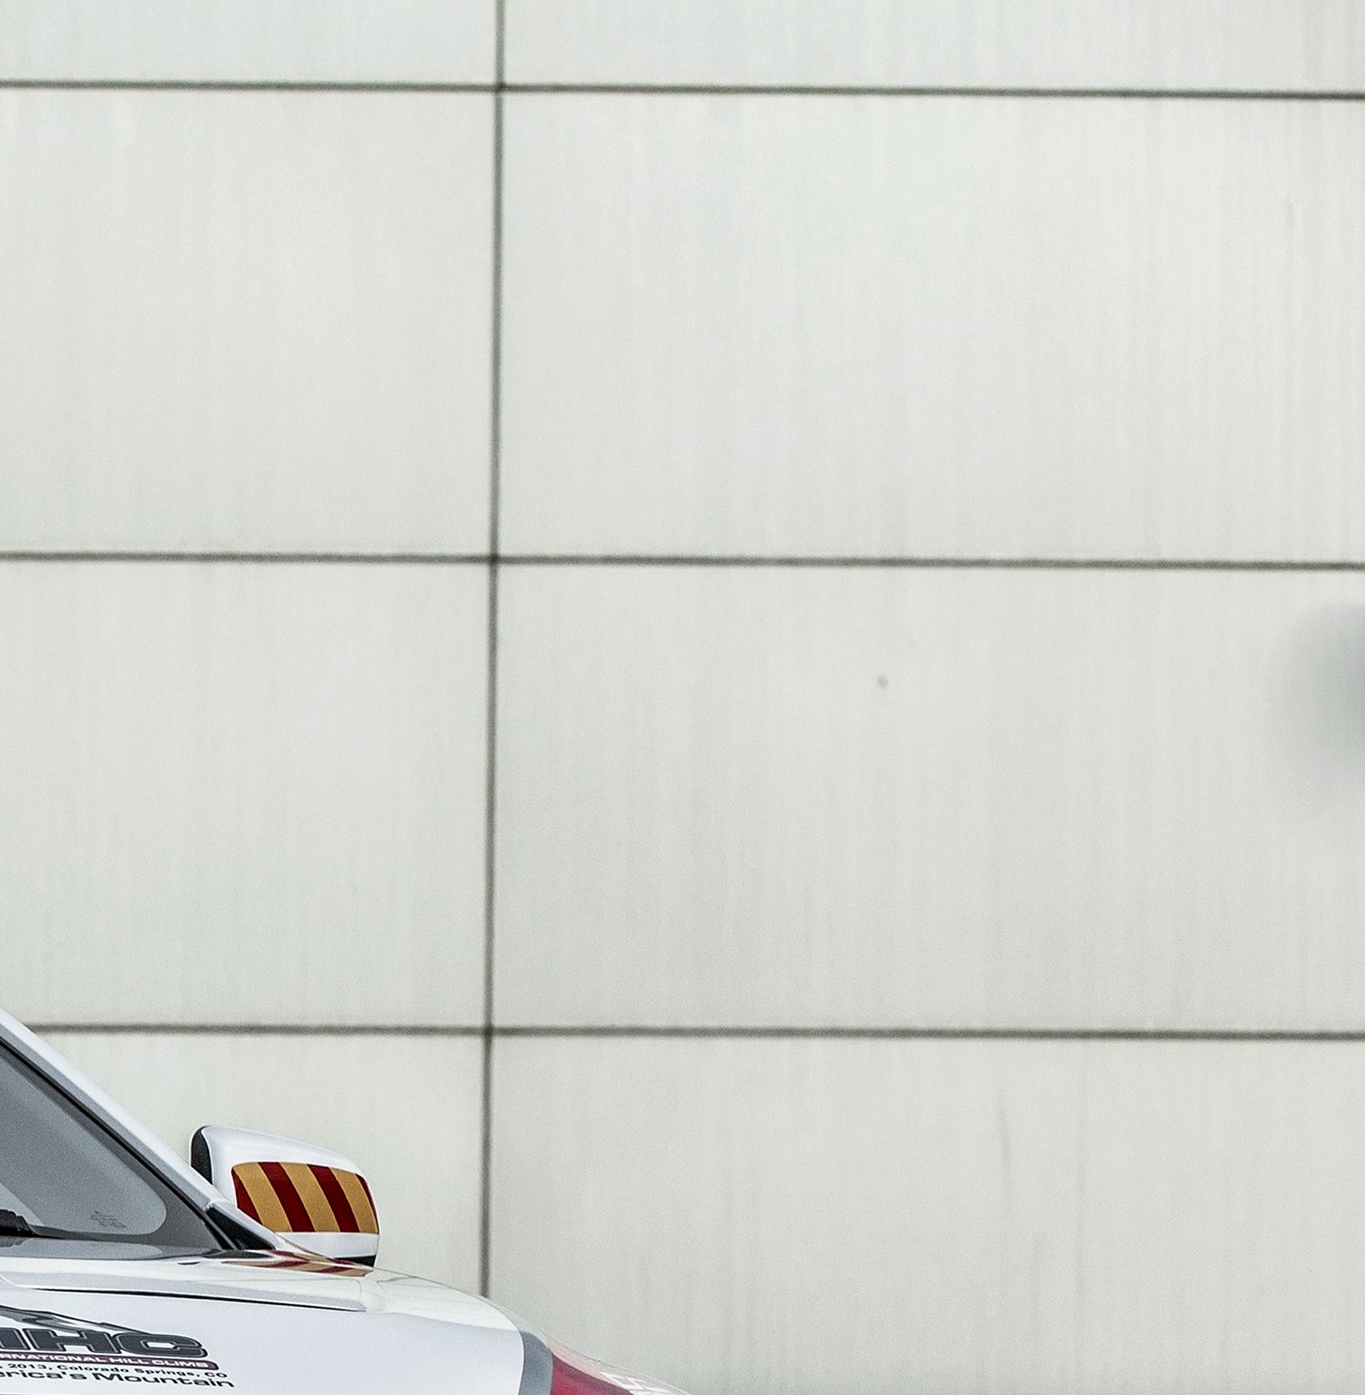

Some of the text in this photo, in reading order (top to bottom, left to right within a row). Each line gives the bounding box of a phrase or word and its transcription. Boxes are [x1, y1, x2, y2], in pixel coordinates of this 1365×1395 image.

[109, 1358, 150, 1366] HILL
[152, 1359, 209, 1368] CLIMB
[56, 1364, 130, 1373] Colorado
[93, 1372, 236, 1388] Mountain
